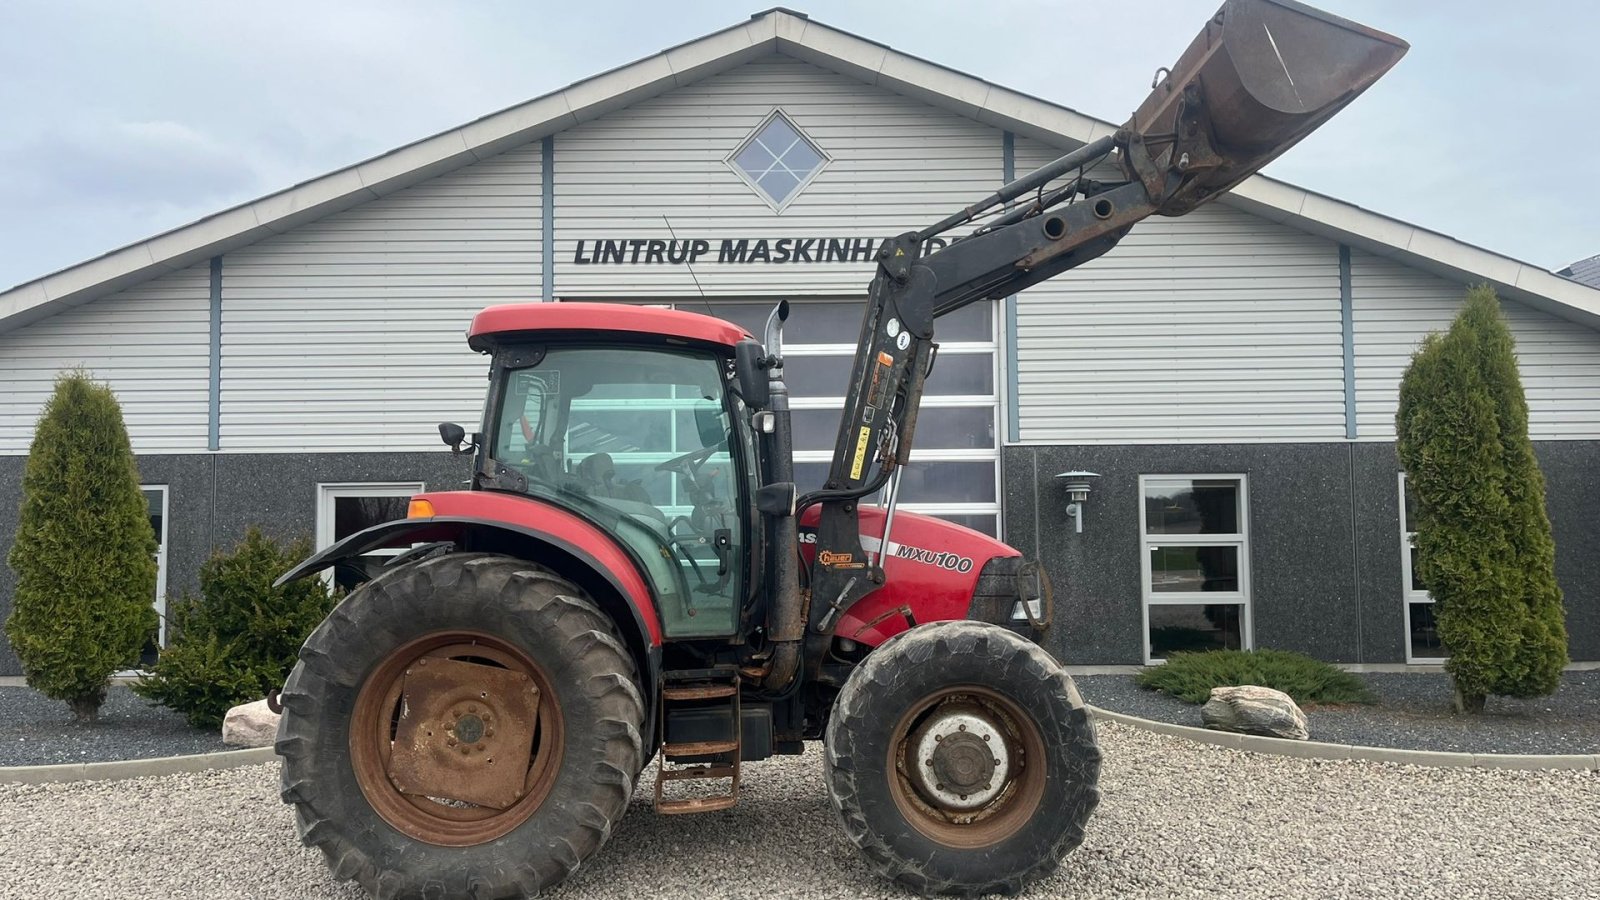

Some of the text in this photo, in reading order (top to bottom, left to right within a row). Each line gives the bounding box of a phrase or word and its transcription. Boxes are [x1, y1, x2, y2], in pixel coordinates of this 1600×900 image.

[574, 239, 710, 264] LINTRUP
[823, 553, 851, 563] hauer
[897, 545, 973, 573] MXU100
